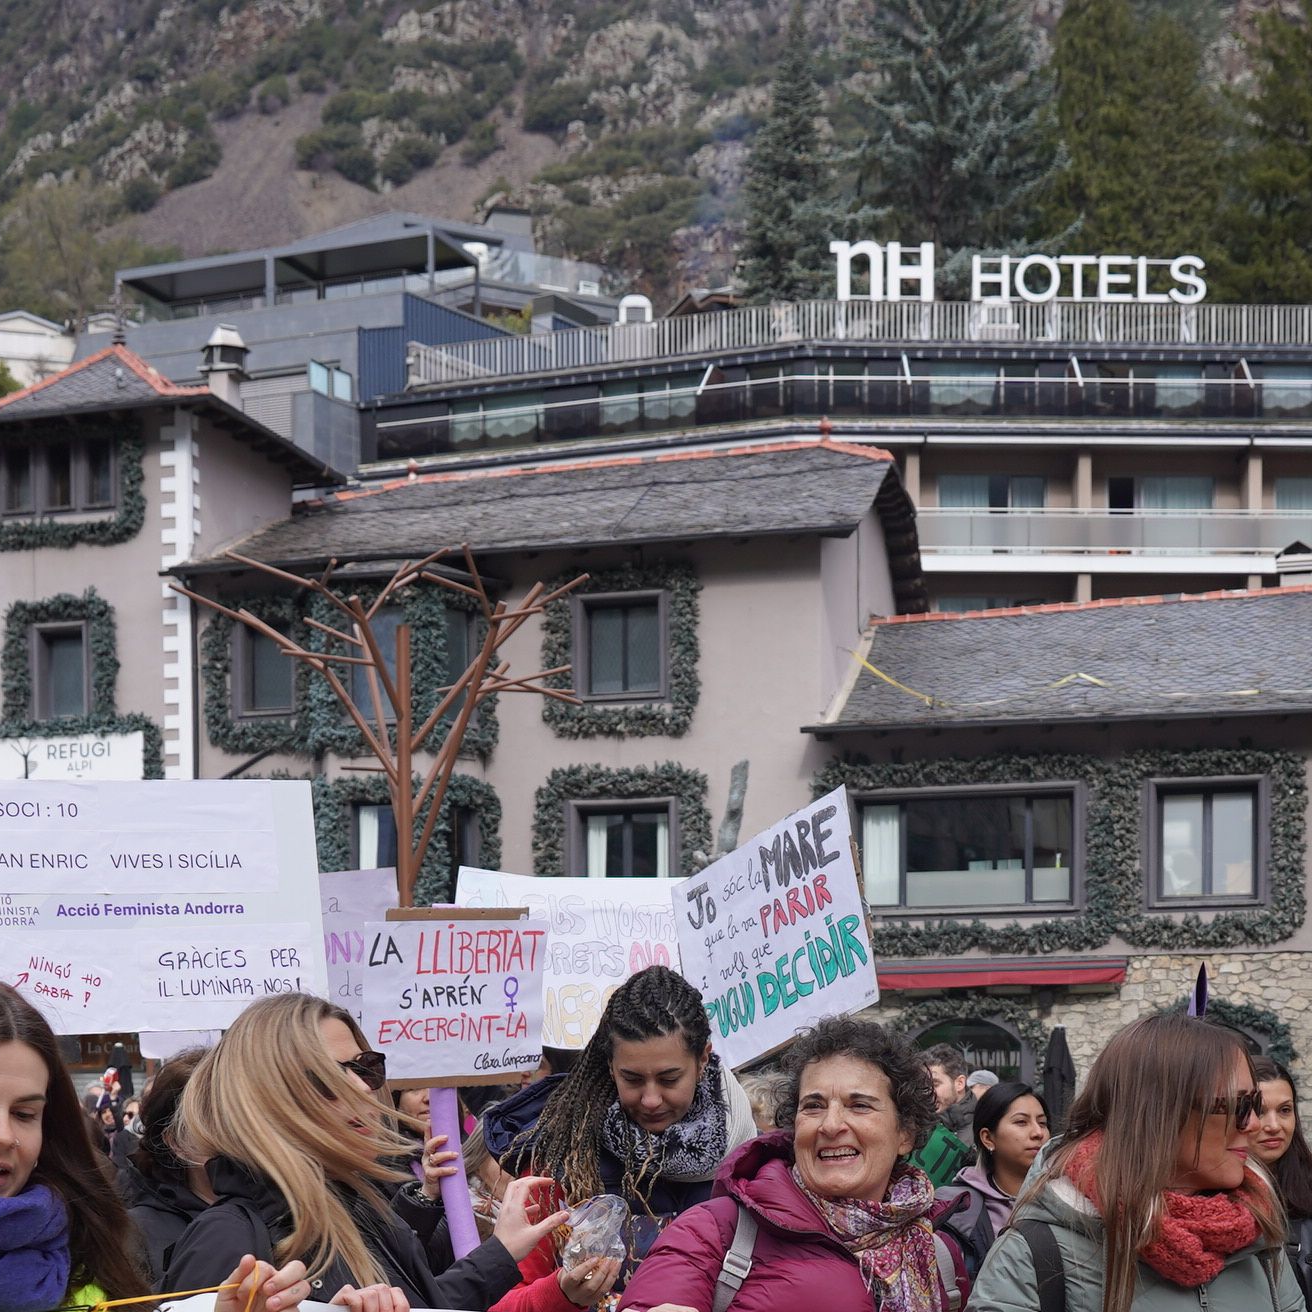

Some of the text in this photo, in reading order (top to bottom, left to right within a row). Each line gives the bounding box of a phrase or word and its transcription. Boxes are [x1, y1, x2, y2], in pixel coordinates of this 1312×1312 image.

[972, 254, 1207, 304] HOTELS
[47, 741, 111, 760] REFUGI
[67, 760, 93, 772] ALPI
[57, 802, 79, 818] 10
[30, 852, 89, 870] ENRIC
[110, 852, 164, 870] VIVES
[168, 853, 173, 869] I
[178, 849, 243, 870] SICÍLIA
[723, 874, 745, 902] sóc
[748, 858, 762, 890] la
[759, 805, 841, 893] MARE
[56, 901, 245, 917] Acció Feminista Andorra
[590, 898, 677, 945] NOSTR
[704, 929, 725, 964] que
[727, 914, 739, 939] la
[759, 874, 833, 939] PARIR
[158, 946, 301, 971] GRÀCIES PER
[369, 923, 546, 976] LA LLIBERTAT
[751, 942, 773, 969] que
[28, 956, 72, 980] NINGÚ
[756, 913, 869, 1018] DECIDIR
[399, 975, 488, 1010] S'APRÉN
[378, 1011, 528, 1045] EXCERCINT-LA
[474, 1052, 501, 1070] Clara
